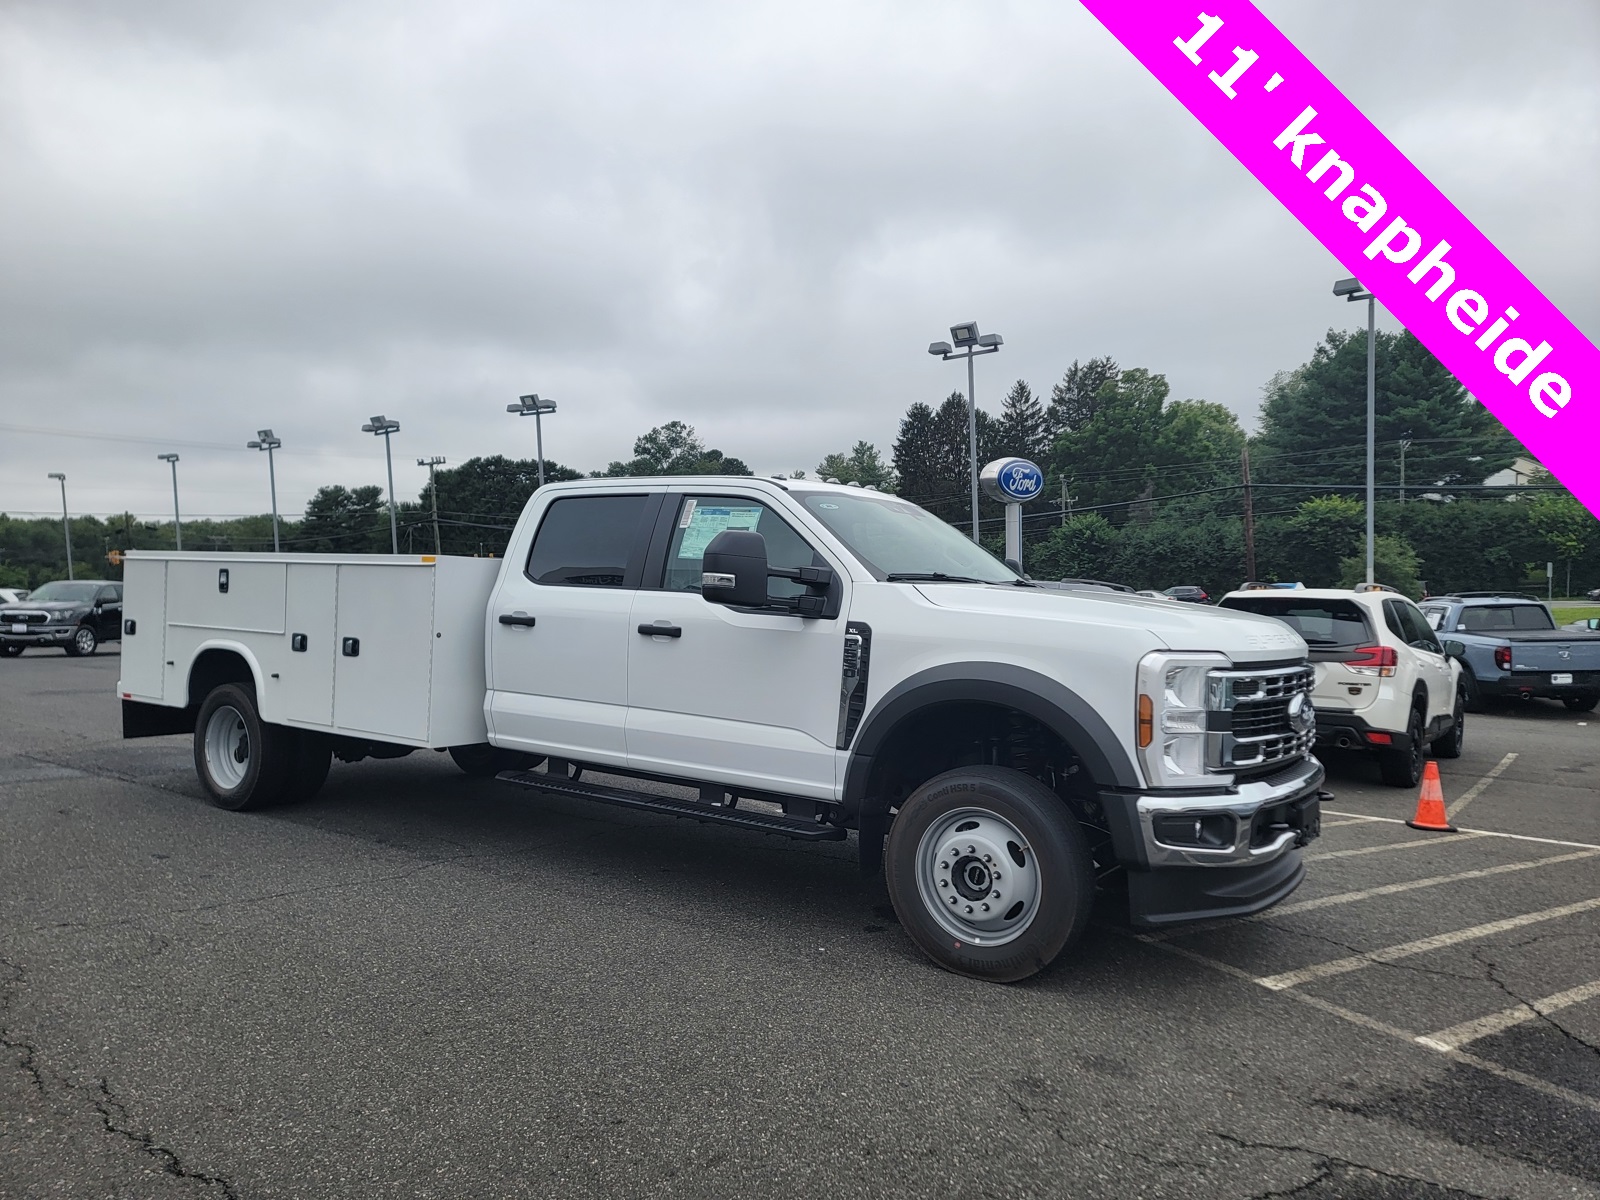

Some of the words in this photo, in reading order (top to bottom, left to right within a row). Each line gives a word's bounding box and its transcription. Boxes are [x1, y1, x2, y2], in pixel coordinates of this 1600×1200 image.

[1009, 467, 1037, 491] Ford
[927, 786, 949, 802] Conti
[950, 784, 968, 793] HSR
